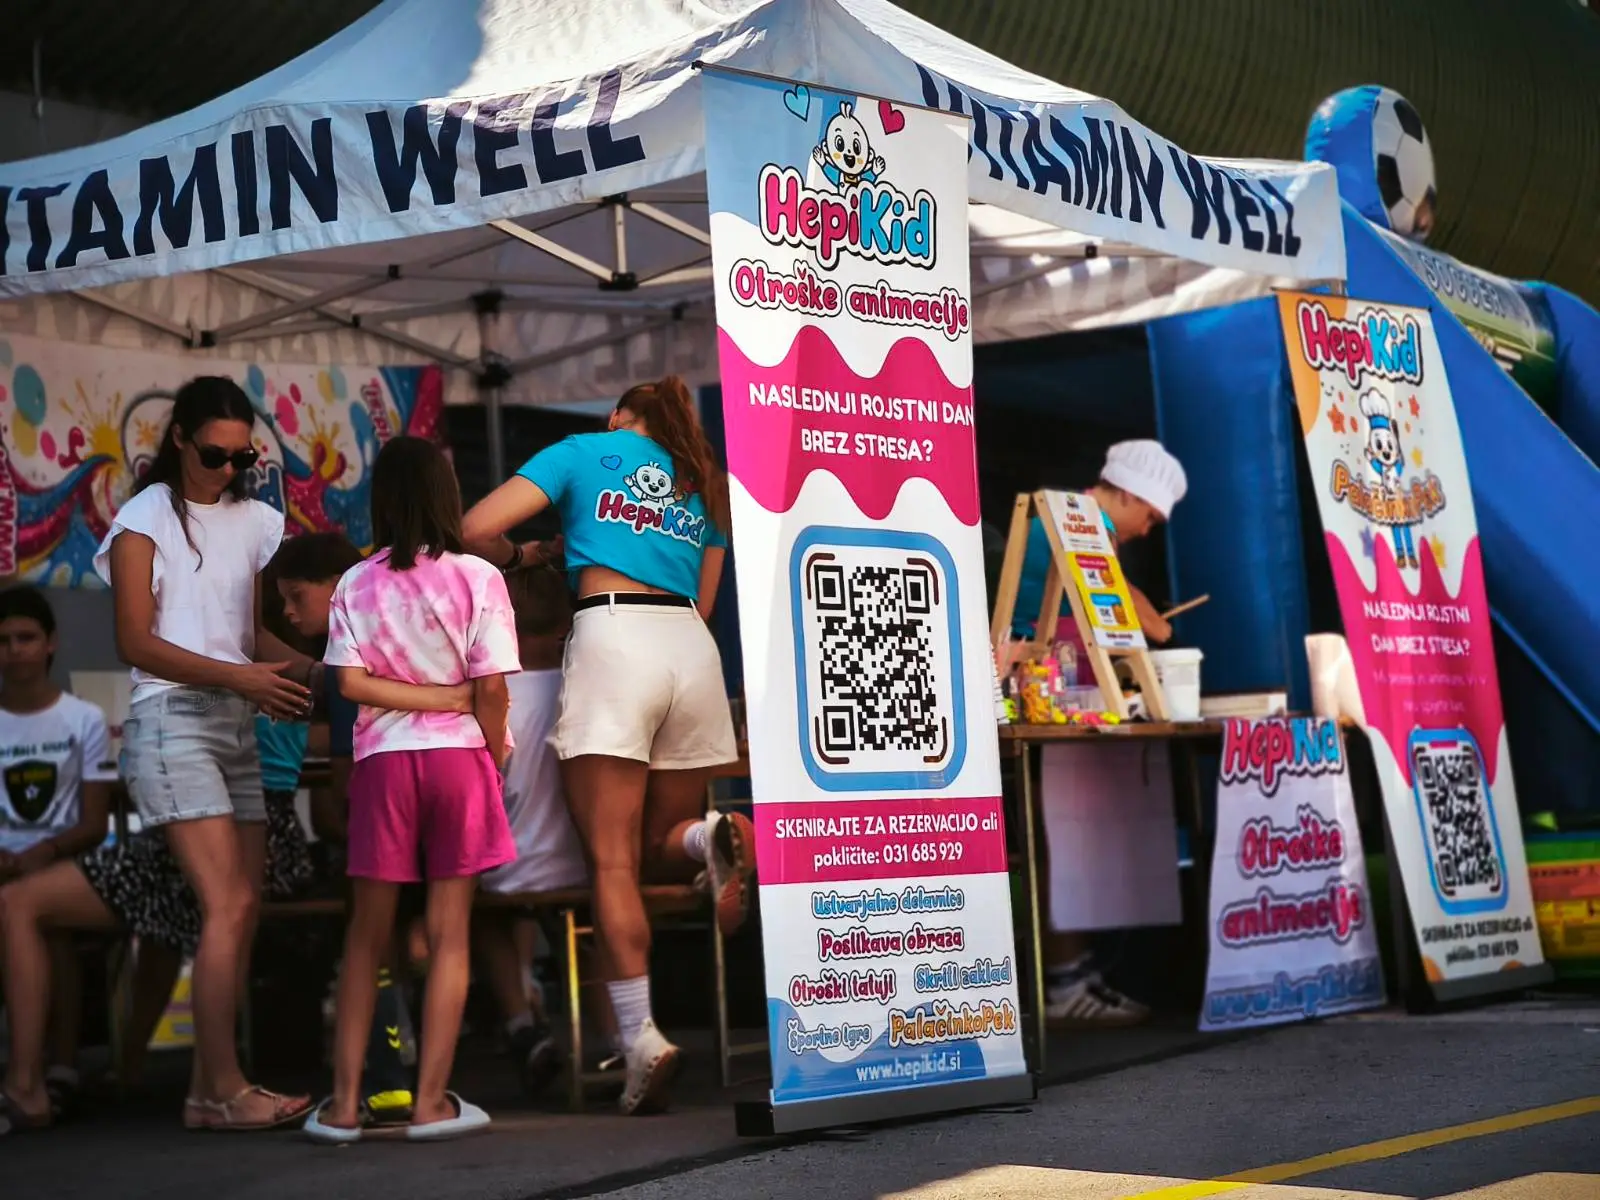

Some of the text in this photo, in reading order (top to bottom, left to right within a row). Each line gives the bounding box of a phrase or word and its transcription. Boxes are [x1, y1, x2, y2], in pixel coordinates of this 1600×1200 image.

[365, 68, 646, 214] WELL
[763, 170, 932, 263] HepiKid
[1166, 144, 1302, 258] WELL
[734, 265, 969, 336] Otroške animacije
[1300, 307, 1419, 382] HepiKid
[748, 382, 975, 427] NASLEDNJI ROJSTNI DAN
[800, 427, 934, 462] BREZ STRESA?
[597, 491, 705, 545] HepiKid
[774, 811, 998, 839] SKENIRAJTE ZA REZERVACIJO ali
[813, 841, 963, 872] pokličite: 031 685 929
[820, 926, 963, 958] Poslikava obraza
[791, 973, 849, 1003] Otroški
[890, 1002, 1015, 1042] PalačinkoPek
[855, 1051, 961, 1083] www.hepikid.si
